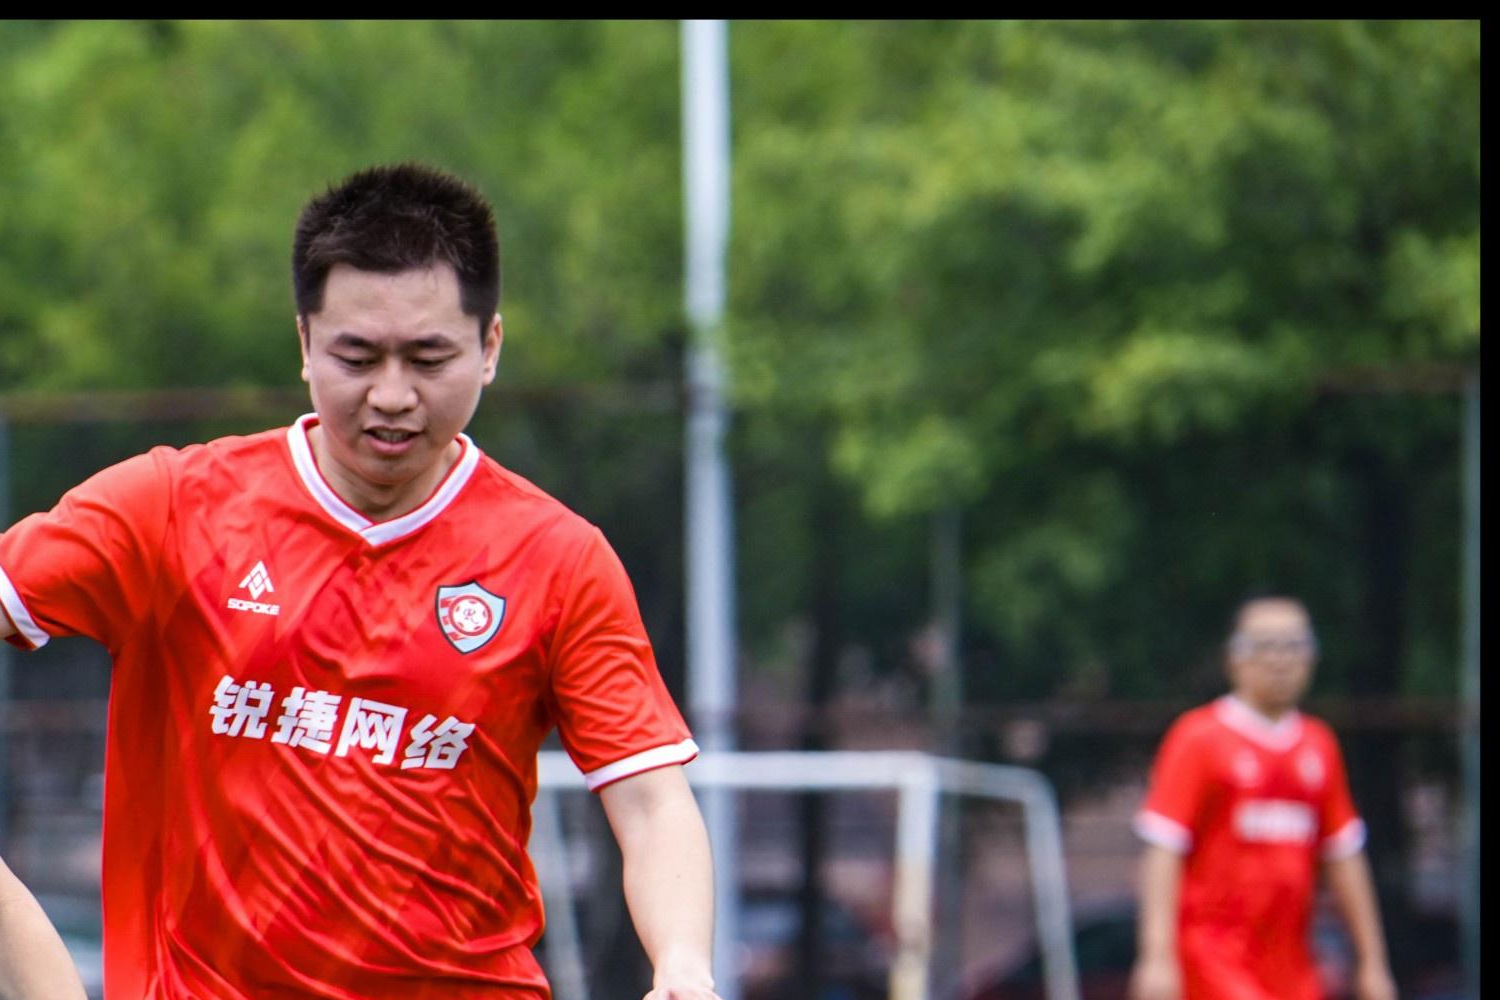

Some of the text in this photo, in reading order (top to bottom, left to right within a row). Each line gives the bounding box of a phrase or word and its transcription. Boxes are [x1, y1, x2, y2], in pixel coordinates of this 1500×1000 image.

[228, 597, 280, 616] SOPOKE
[209, 675, 475, 770] 锐捷网络
